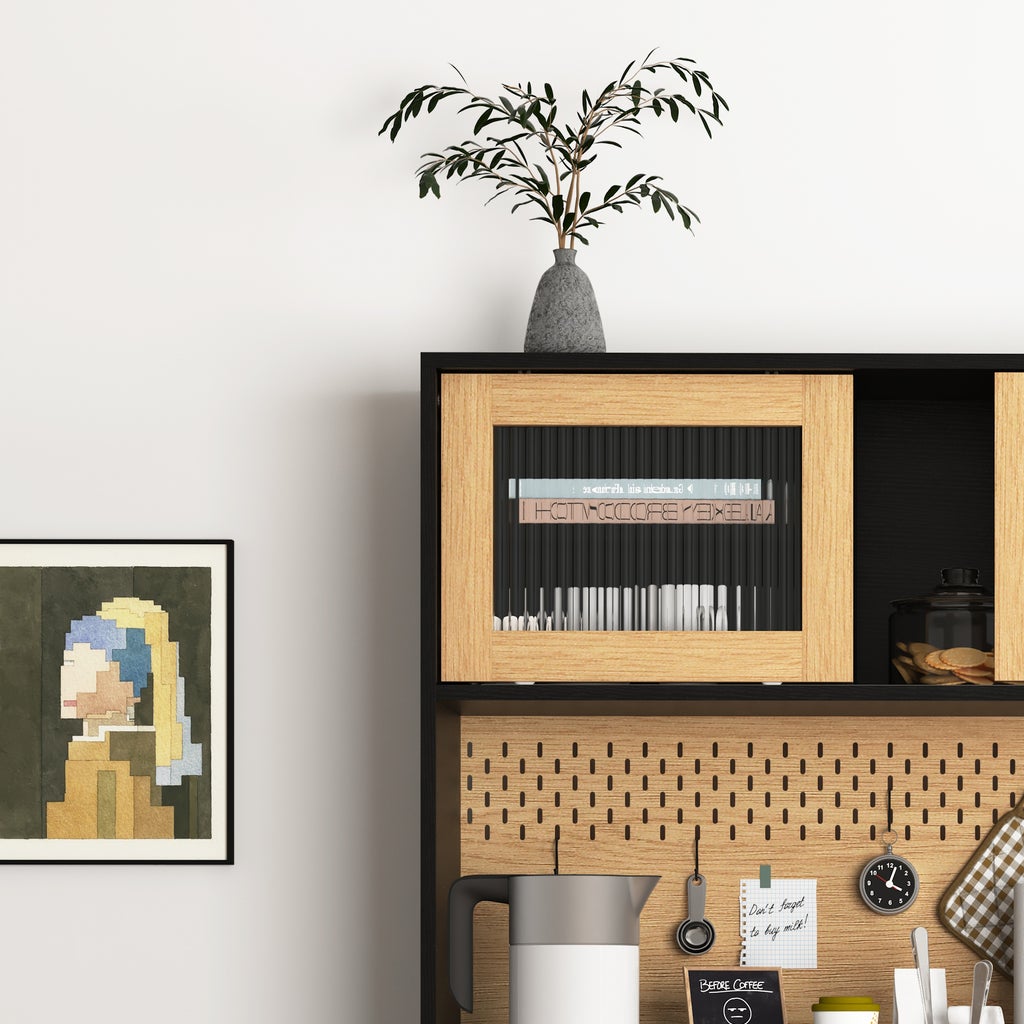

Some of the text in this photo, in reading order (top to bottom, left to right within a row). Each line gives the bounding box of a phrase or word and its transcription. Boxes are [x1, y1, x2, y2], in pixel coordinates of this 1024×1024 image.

[778, 896, 805, 913] forget
[750, 913, 808, 941] to buy milk!
[699, 978, 765, 993] BEFORE COFFEE
